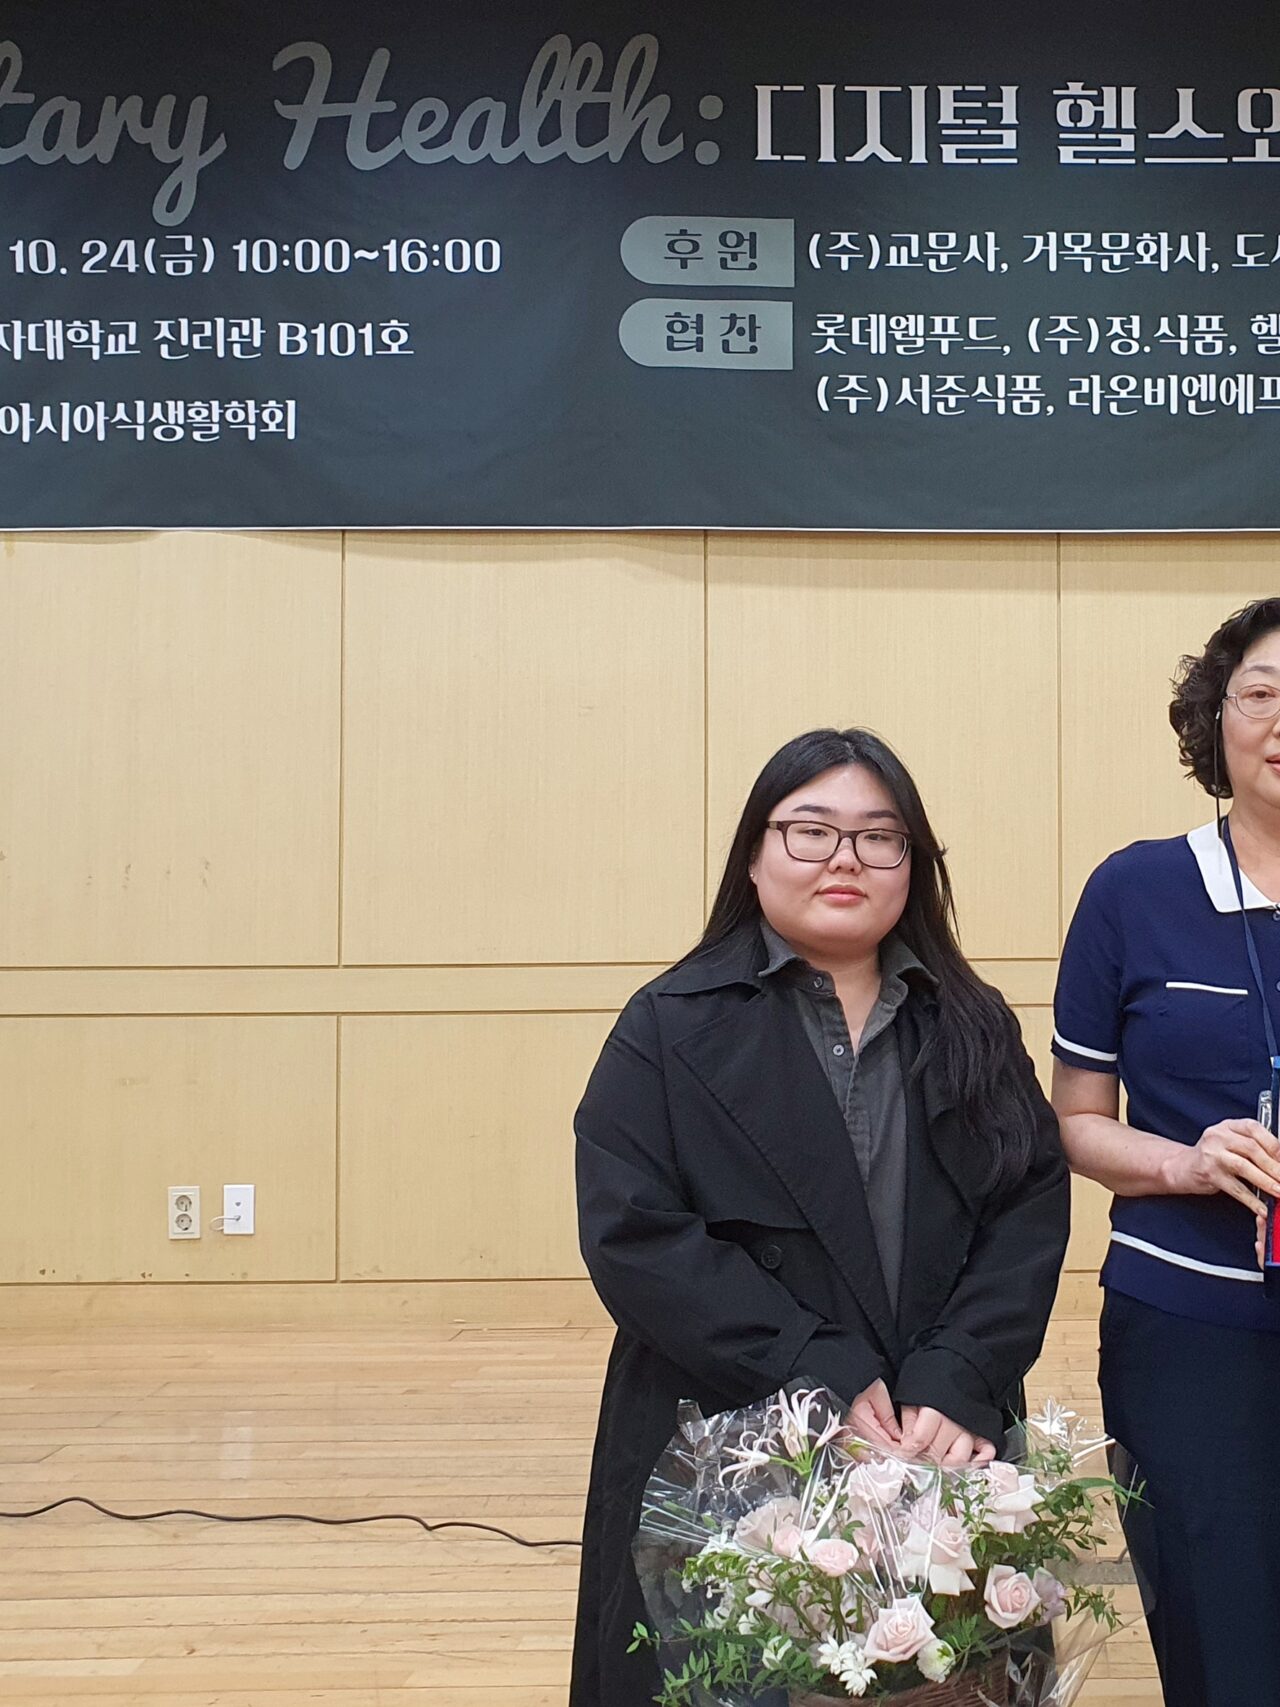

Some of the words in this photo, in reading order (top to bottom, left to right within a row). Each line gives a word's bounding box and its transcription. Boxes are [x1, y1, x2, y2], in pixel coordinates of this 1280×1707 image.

[272, 33, 724, 171] Health:
[754, 84, 1019, 164] 디지털
[8, 239, 68, 275] 10.
[81, 235, 215, 276] 24(금)
[232, 238, 501, 275] 10:00~16:00
[808, 231, 1009, 274] (주)교문사,
[1022, 231, 1220, 274] 거목문화사,
[153, 317, 267, 360] 진리관
[277, 319, 415, 357] B101호
[811, 313, 1011, 356] 롯데웰푸드,
[816, 374, 1055, 416] (주)서준식품,
[0, 399, 296, 443] 아시아식생활학회
